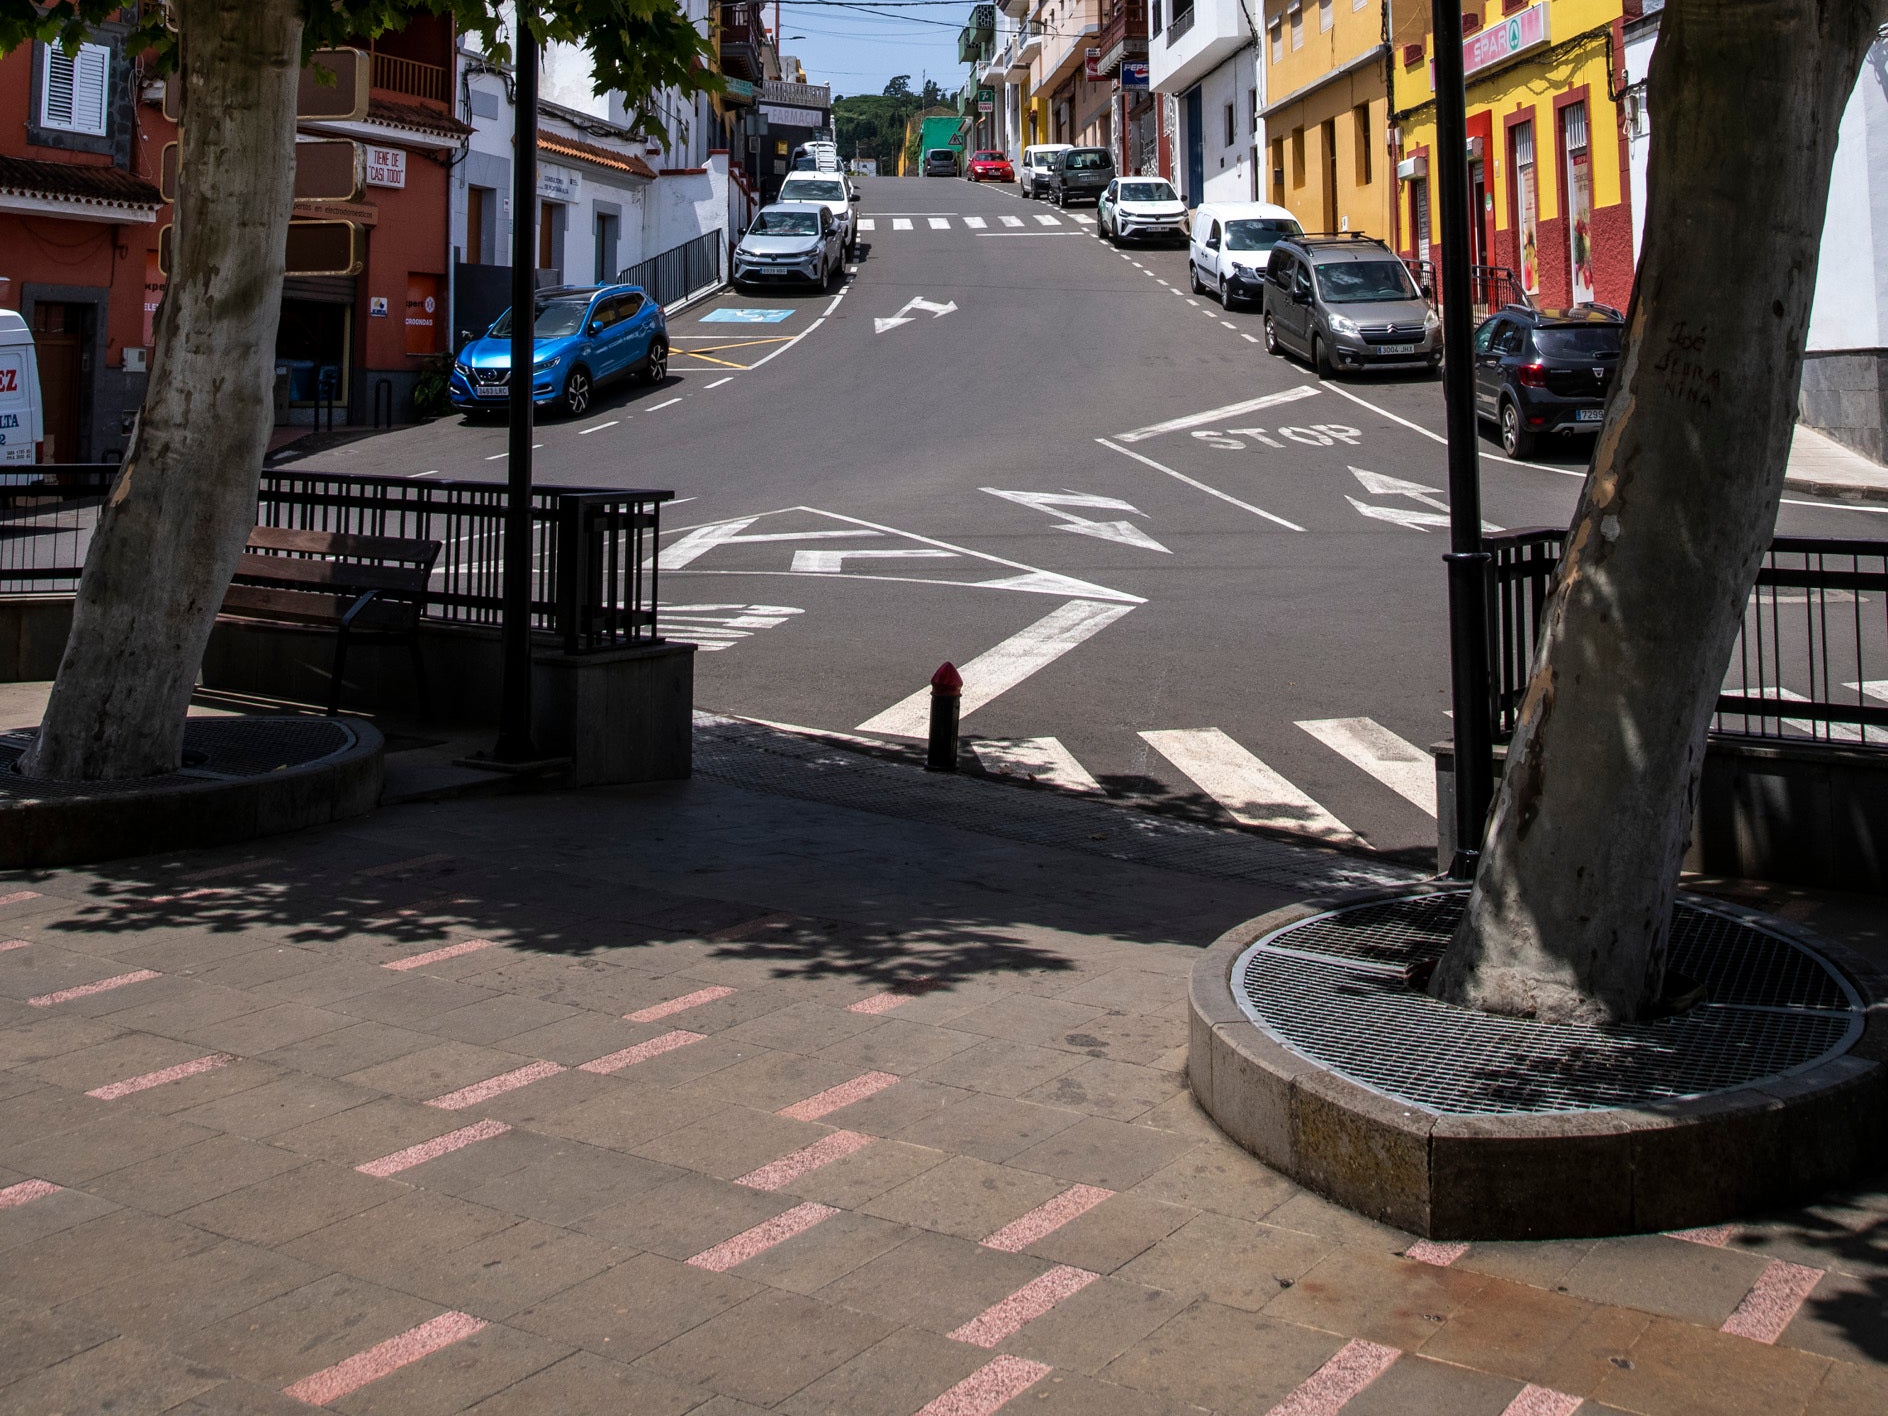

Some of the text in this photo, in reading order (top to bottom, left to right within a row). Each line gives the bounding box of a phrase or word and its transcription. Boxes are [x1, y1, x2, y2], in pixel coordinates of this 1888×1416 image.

[1473, 30, 1507, 62] SPAR
[772, 109, 820, 125] FARMACIA
[374, 150, 399, 167] TIENE DE
[368, 165, 404, 184] "CASI TODO"
[1191, 424, 1363, 450] STOP
